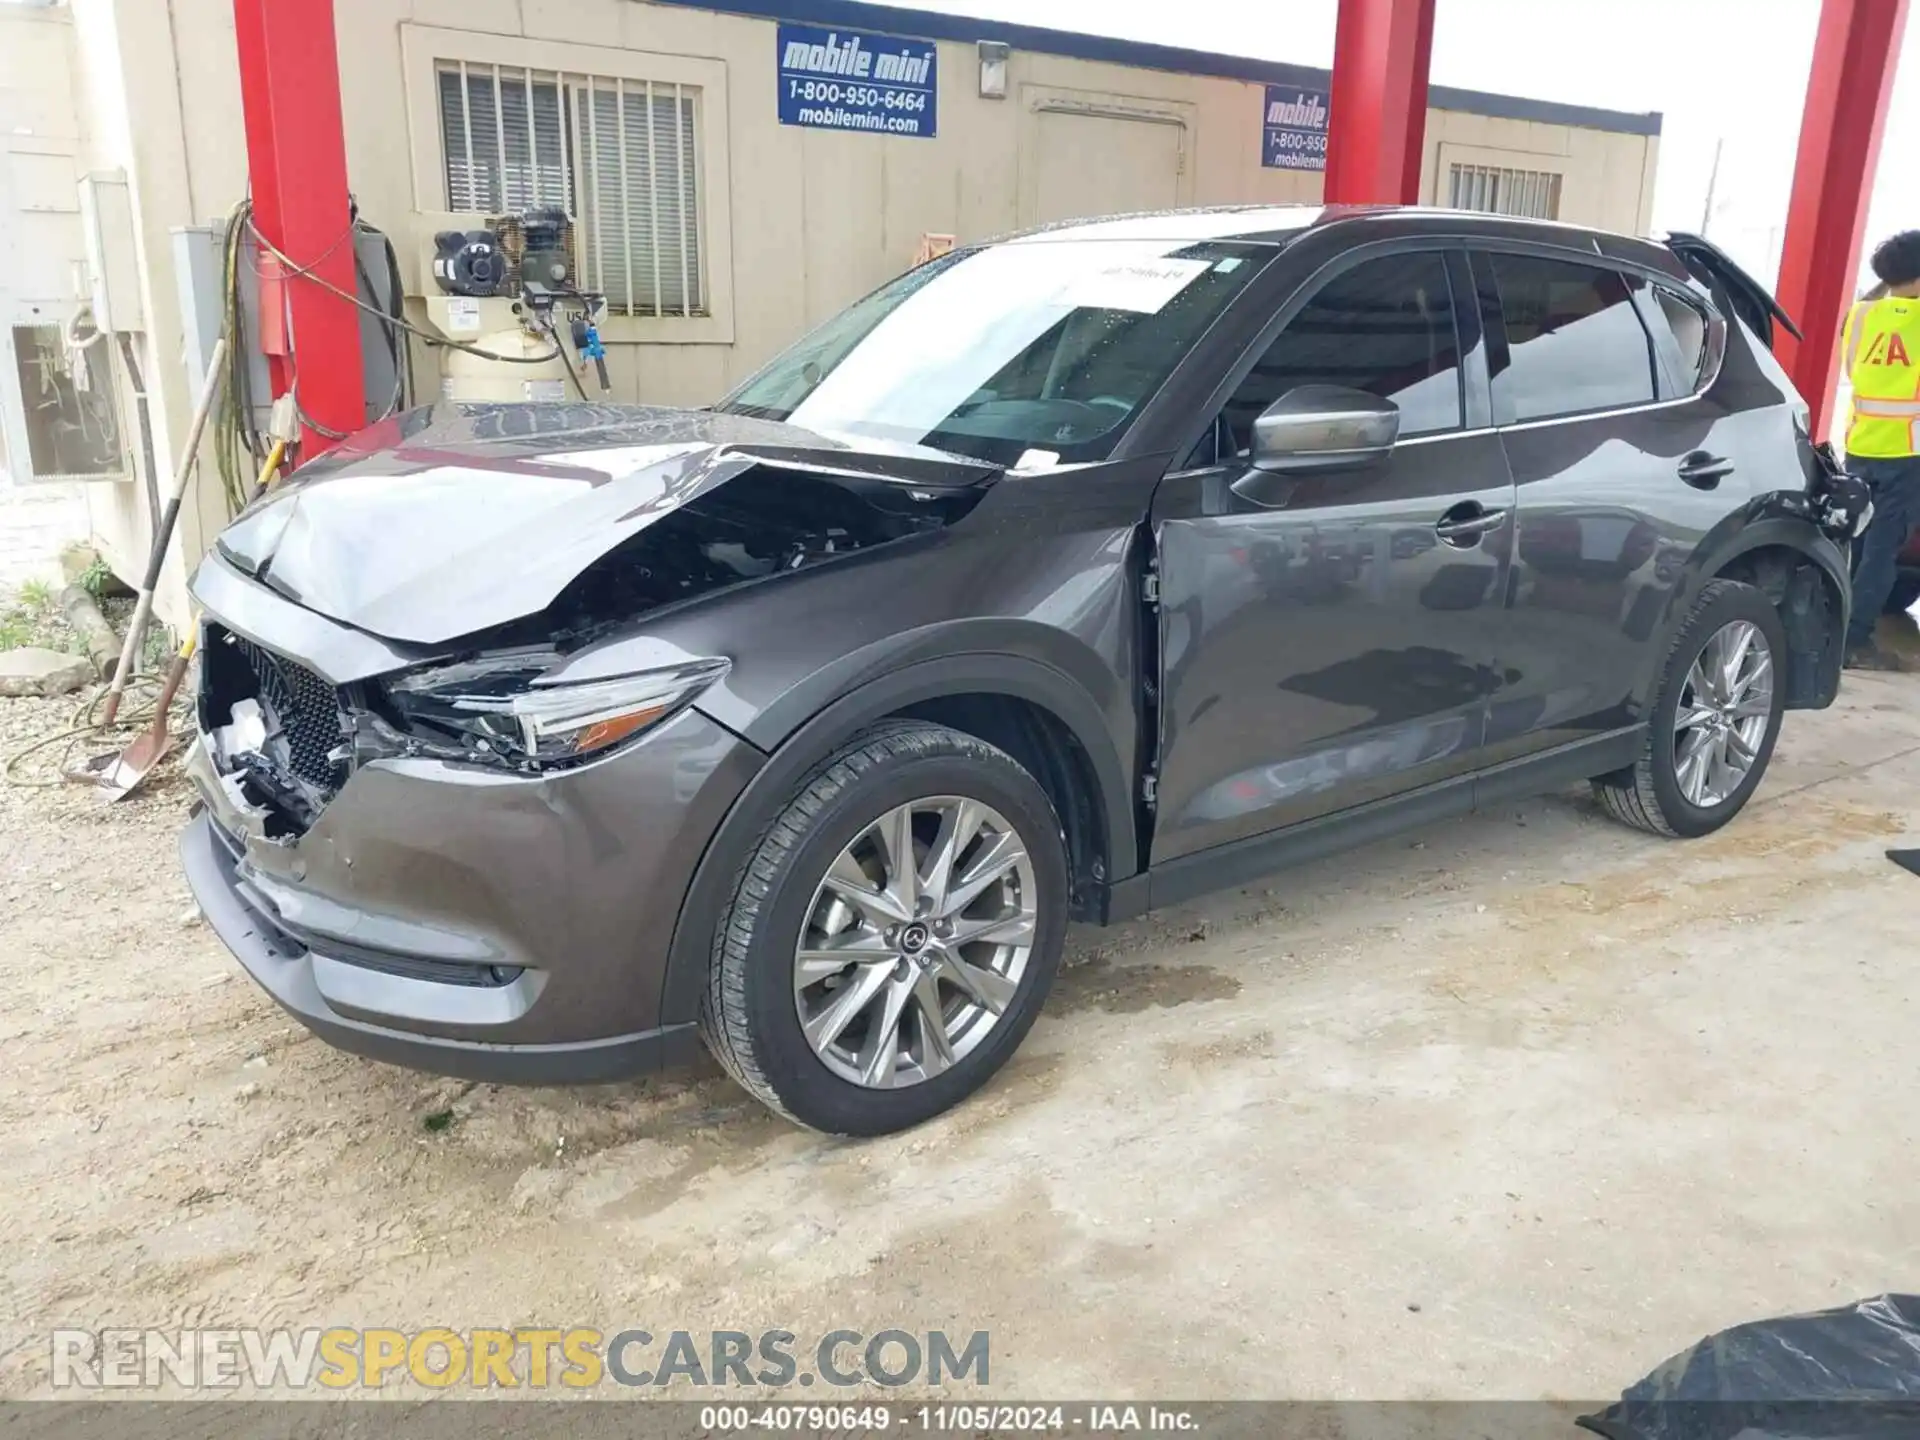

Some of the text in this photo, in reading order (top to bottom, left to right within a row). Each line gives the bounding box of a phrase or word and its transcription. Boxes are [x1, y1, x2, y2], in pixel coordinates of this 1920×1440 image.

[782, 33, 931, 84] mobile mini
[789, 80, 925, 112] 1-800-950-6464
[1267, 93, 1326, 129] mobile
[798, 107, 919, 132] mobilemini.com
